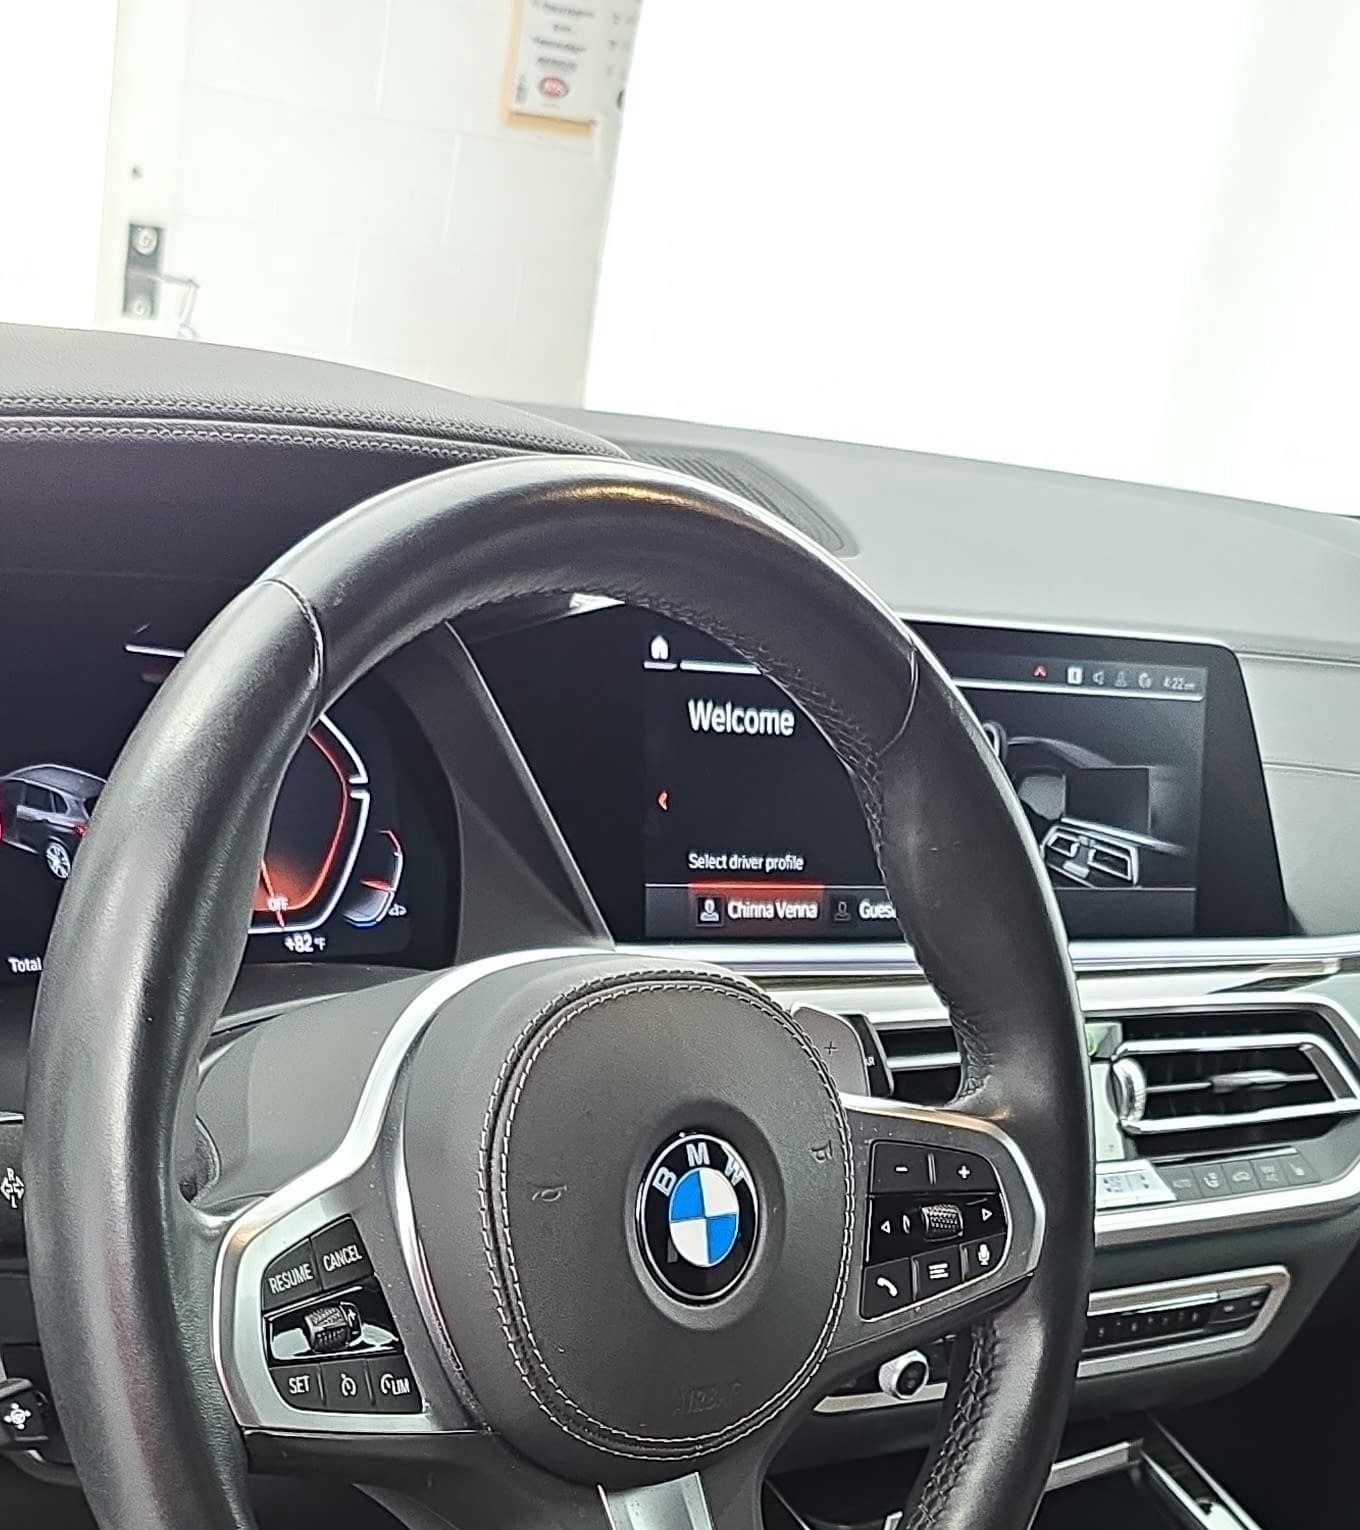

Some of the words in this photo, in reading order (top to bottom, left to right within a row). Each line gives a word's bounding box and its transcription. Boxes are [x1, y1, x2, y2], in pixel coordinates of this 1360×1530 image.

[688, 700, 795, 736] Welcome
[689, 854, 727, 869] Select
[729, 854, 764, 870] driver
[765, 856, 804, 873] profile
[727, 901, 774, 919] Chinna
[775, 902, 818, 919] Venna
[7, 956, 42, 973] Total
[652, 1142, 746, 1198] BMW
[323, 1245, 363, 1273] CANCEL
[268, 1263, 314, 1294] RESUME
[288, 1375, 311, 1395] SET
[391, 1380, 410, 1396] LIM
